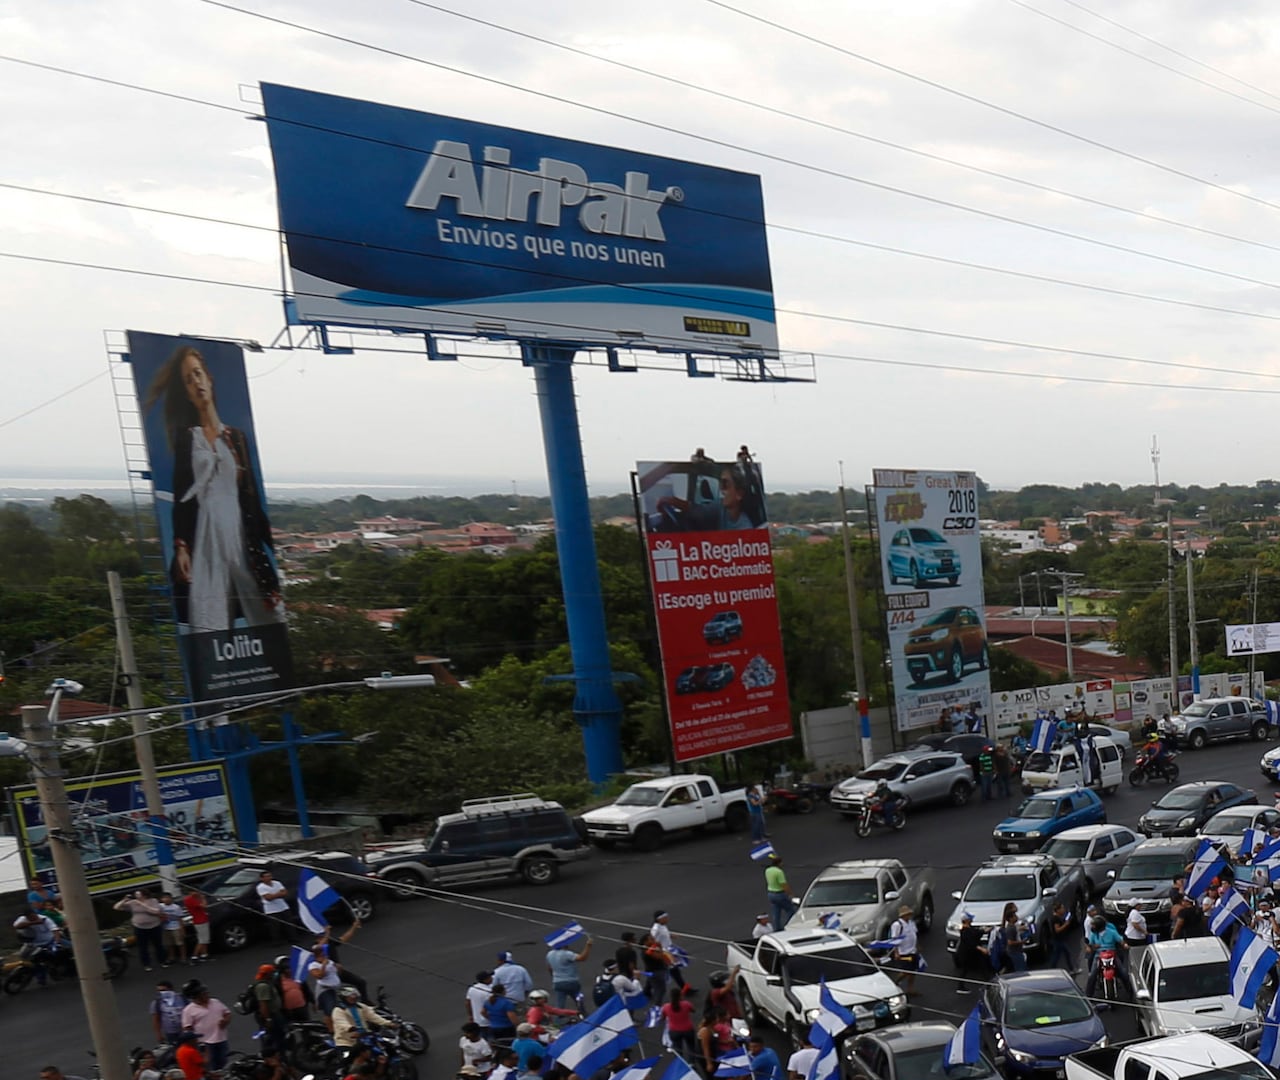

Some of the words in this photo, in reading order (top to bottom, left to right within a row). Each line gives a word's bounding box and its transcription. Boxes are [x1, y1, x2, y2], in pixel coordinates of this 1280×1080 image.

[404, 140, 668, 242] AirPak
[438, 219, 517, 251] Envíos
[523, 235, 565, 258] que
[571, 241, 609, 262] nos
[614, 248, 665, 269] unen
[925, 476, 952, 489] Great
[948, 490, 976, 513] 2018
[942, 516, 977, 530] C30
[680, 542, 699, 562] La
[701, 538, 769, 563] Regalona
[683, 566, 708, 581] BAC
[710, 560, 771, 579] Credomatic
[658, 592, 712, 610] ¡Escoge
[714, 591, 727, 604] tu
[730, 584, 775, 605] premio!
[888, 594, 904, 609] FULL
[890, 611, 916, 625] M4
[213, 635, 264, 661] Lolita
